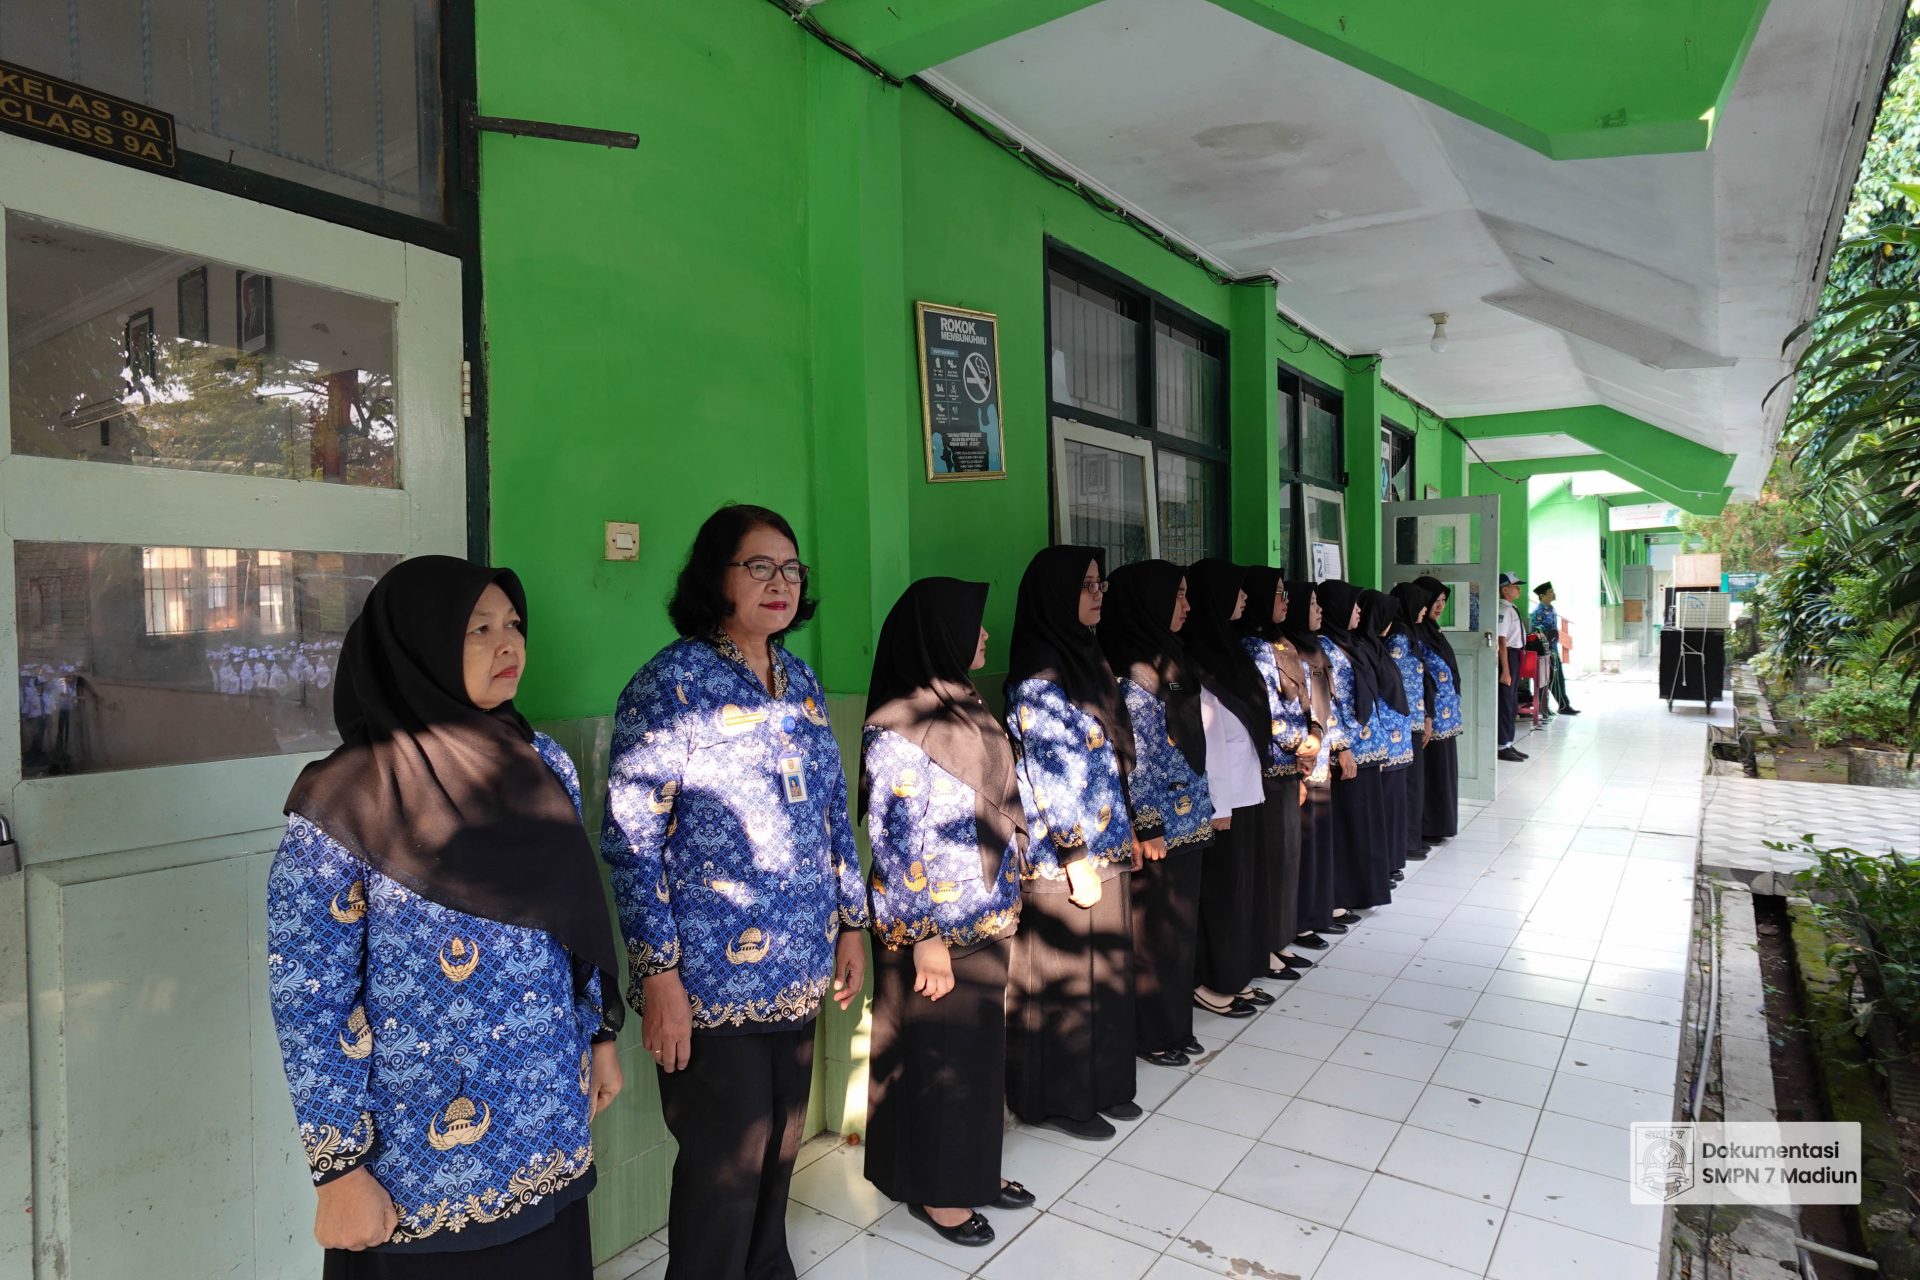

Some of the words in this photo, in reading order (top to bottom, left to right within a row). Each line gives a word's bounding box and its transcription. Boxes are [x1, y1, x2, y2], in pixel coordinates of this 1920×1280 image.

[0, 70, 112, 120] KELAS
[121, 110, 161, 136] 9A
[0, 98, 114, 145] CLASS
[123, 135, 162, 161] 9A
[940, 317, 976, 335] ROKOK
[940, 331, 987, 345] MEMBUNUHMU
[1317, 558, 1323, 577] 2
